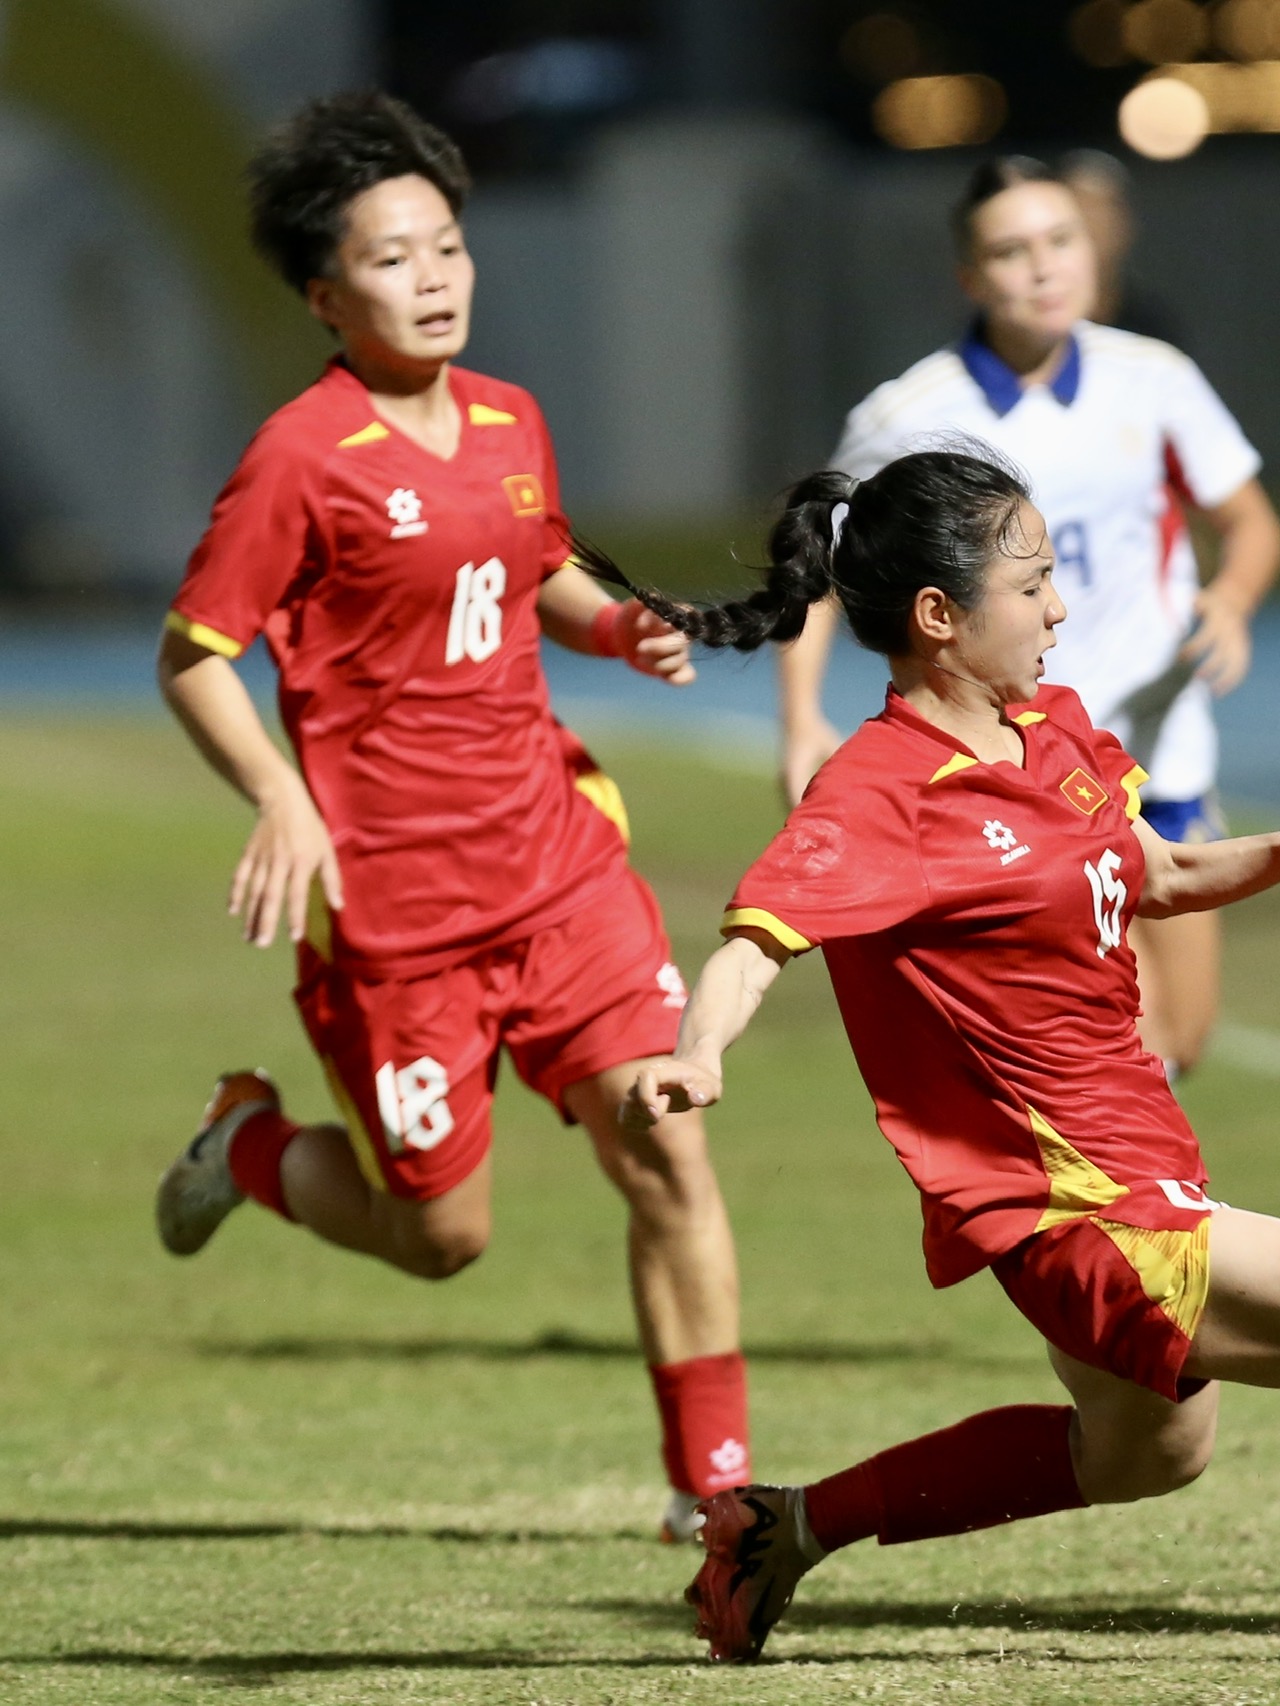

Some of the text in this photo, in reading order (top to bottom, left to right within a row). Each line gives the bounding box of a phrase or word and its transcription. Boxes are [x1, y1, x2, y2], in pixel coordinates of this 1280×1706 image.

[446, 556, 507, 665] 18
[1083, 848, 1127, 959] 15
[375, 1055, 455, 1154] 18
